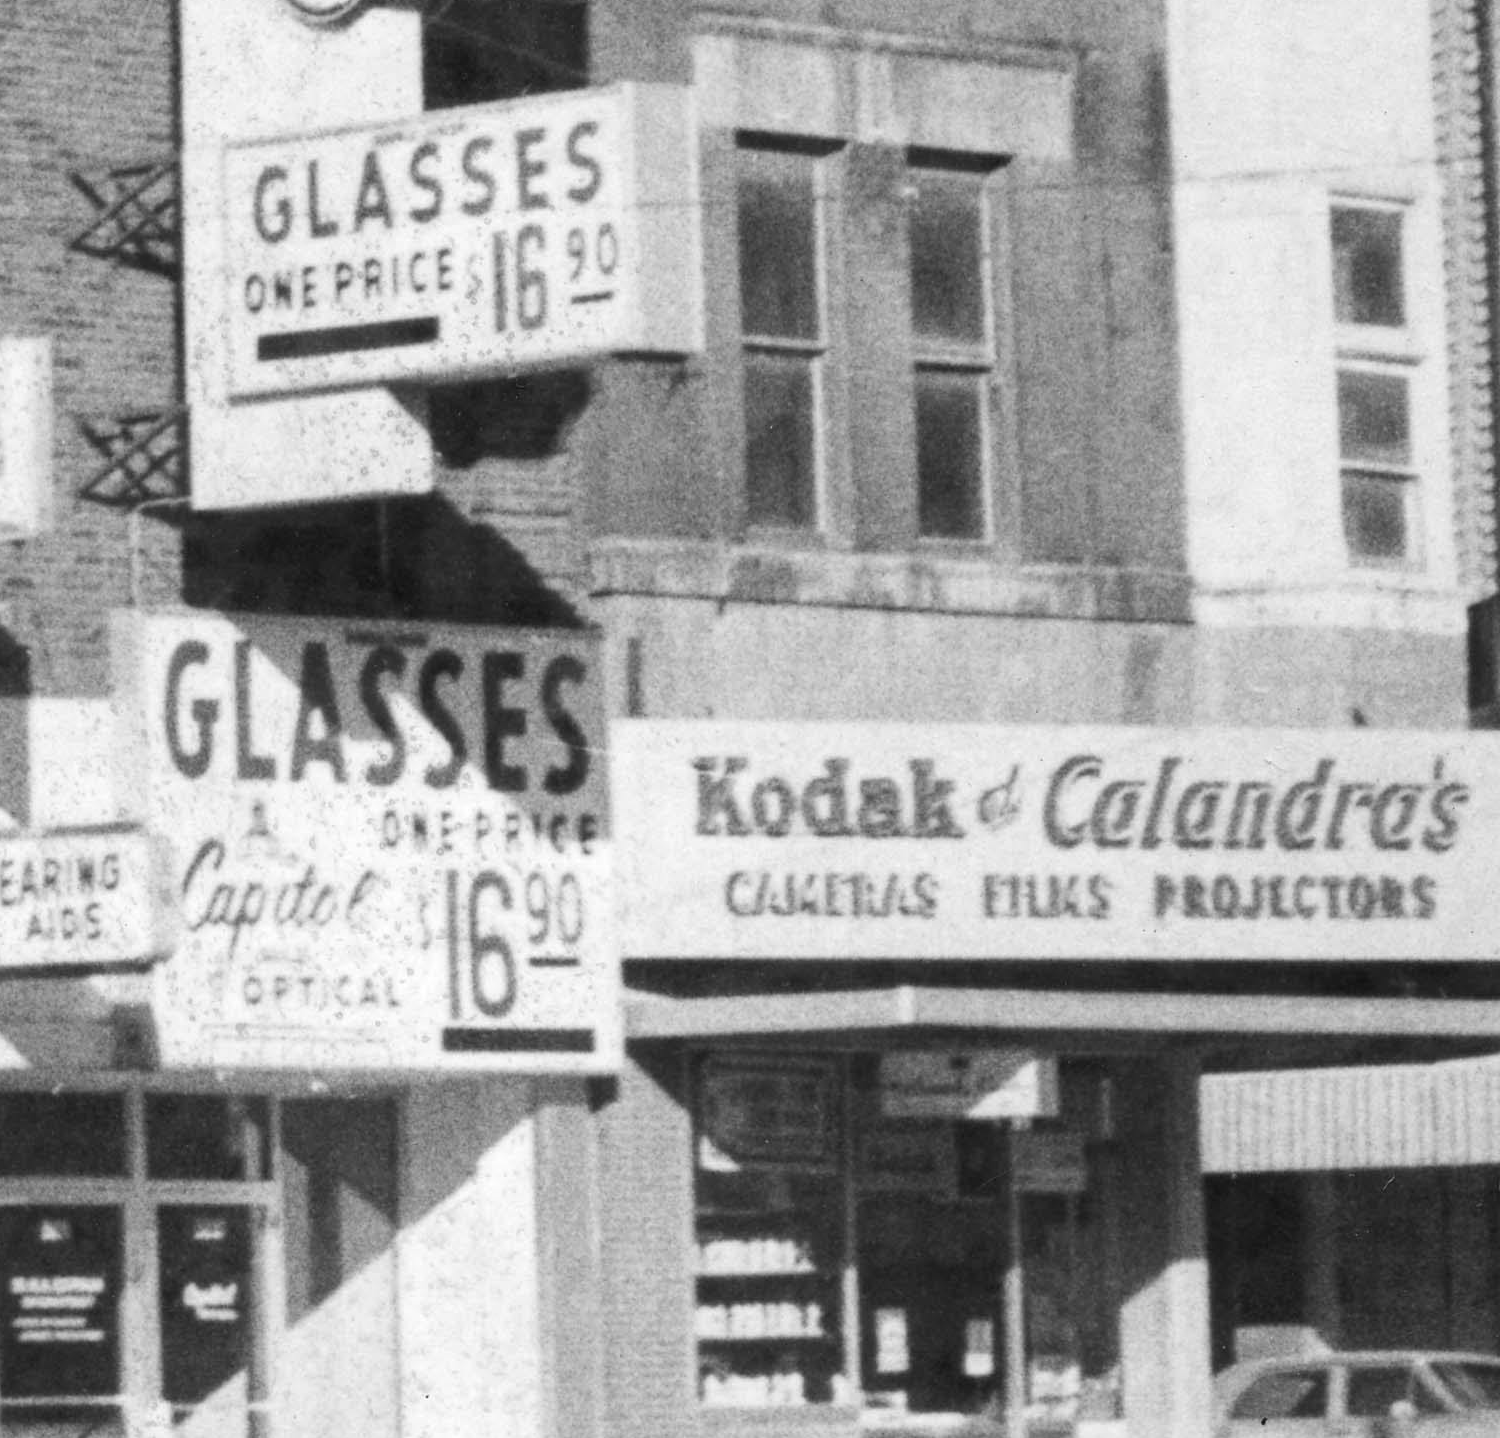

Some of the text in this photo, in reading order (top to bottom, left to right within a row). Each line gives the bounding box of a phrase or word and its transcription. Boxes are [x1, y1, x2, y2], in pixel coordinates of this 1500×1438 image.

[252, 120, 600, 243] GLASSES
[243, 265, 318, 316] ONE
[335, 248, 454, 300] PRICE
[164, 639, 590, 796] GLASSES
[692, 756, 966, 838] Kodak
[1043, 755, 1469, 853] Calandra's
[26, 901, 102, 941] AIDS
[725, 871, 1436, 920] CAMERAS FILMS PROJECTORS
[244, 975, 400, 1008] OPTICAL
